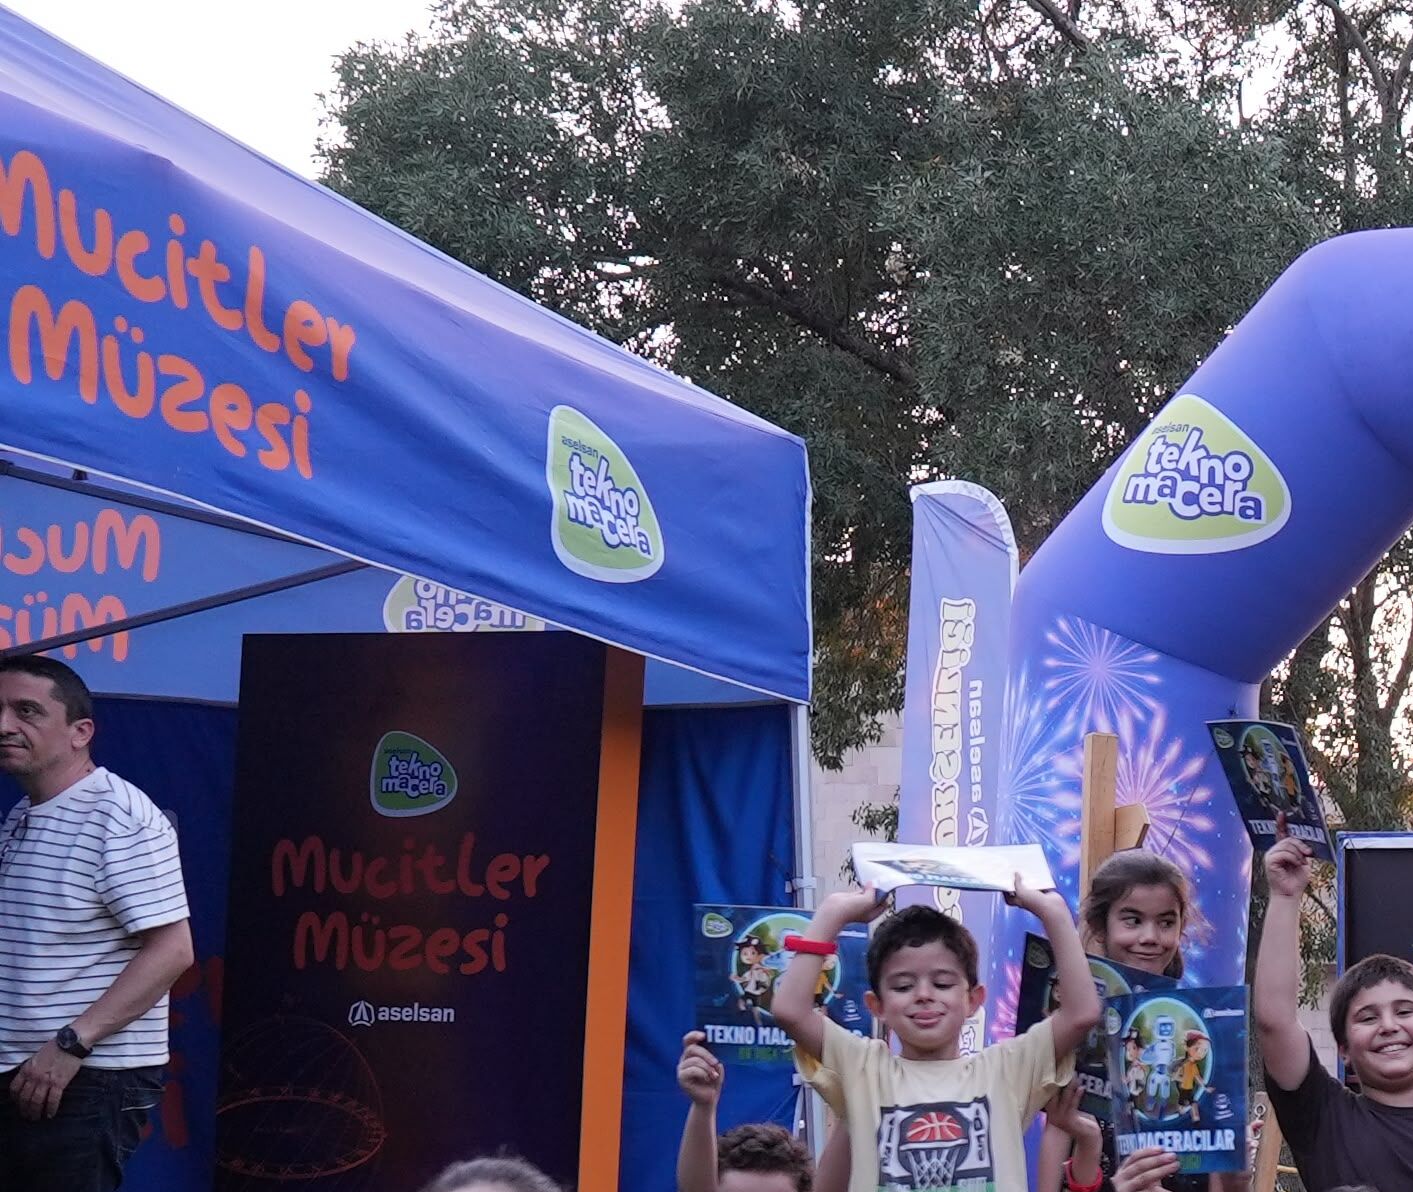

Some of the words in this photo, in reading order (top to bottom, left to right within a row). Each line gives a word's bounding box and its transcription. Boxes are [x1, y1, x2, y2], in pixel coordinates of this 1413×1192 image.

[0, 150, 355, 382] Mucitler
[9, 284, 313, 479] Müzesi
[561, 436, 598, 458] aselsan
[1145, 427, 1254, 484] tekno
[569, 452, 639, 518] tekno
[1123, 471, 1266, 525] macera
[564, 490, 654, 559] macera
[381, 774, 447, 798] macera
[388, 751, 443, 779] tekno
[271, 831, 551, 900] Mucitler
[293, 910, 509, 975] Müzesi
[377, 1001, 455, 1024] aselsan
[704, 1024, 755, 1045] TEKNO
[1138, 1128, 1236, 1152] MACERACILAR
